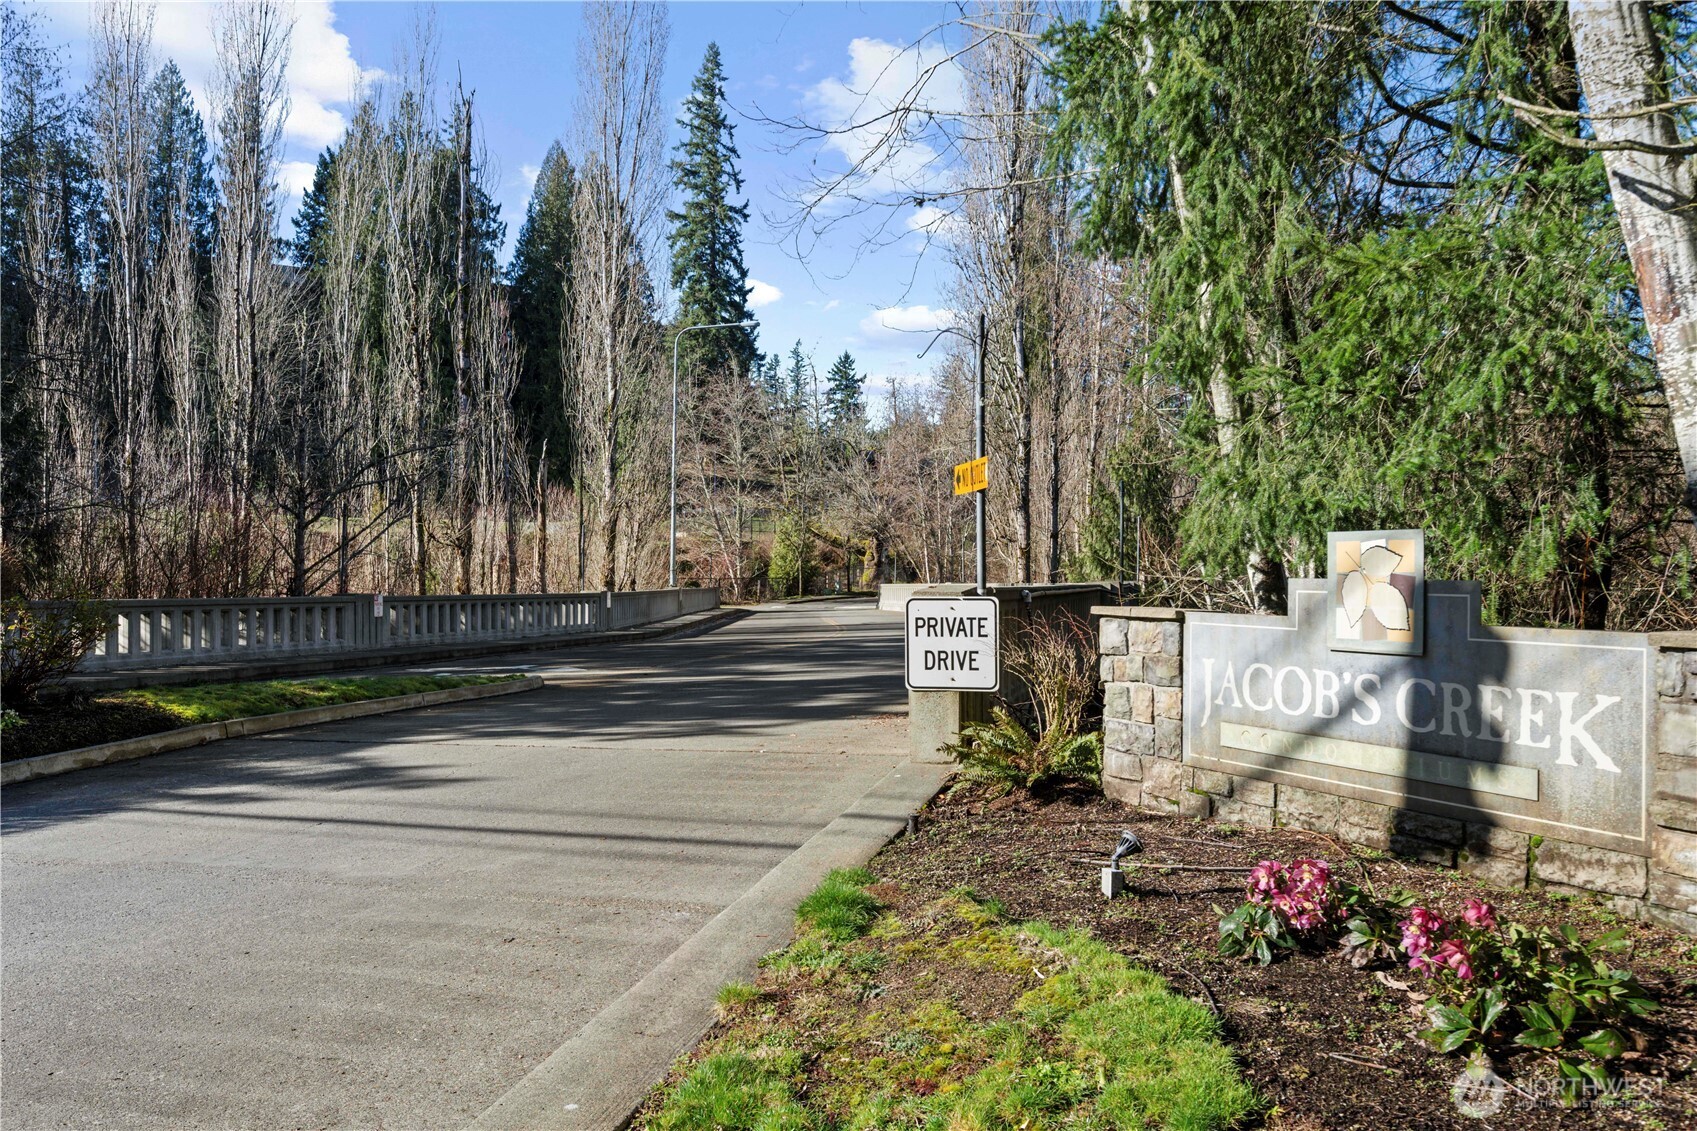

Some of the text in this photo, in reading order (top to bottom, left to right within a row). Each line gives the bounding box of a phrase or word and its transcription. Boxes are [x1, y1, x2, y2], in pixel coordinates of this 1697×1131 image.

[970, 461, 986, 486] OUTLET
[914, 616, 989, 638] PRIVATE
[923, 649, 980, 671] DRIVE
[1200, 658, 1621, 773] JACOB'S CREEK
[1240, 729, 1510, 791] CONDOIIUMS
